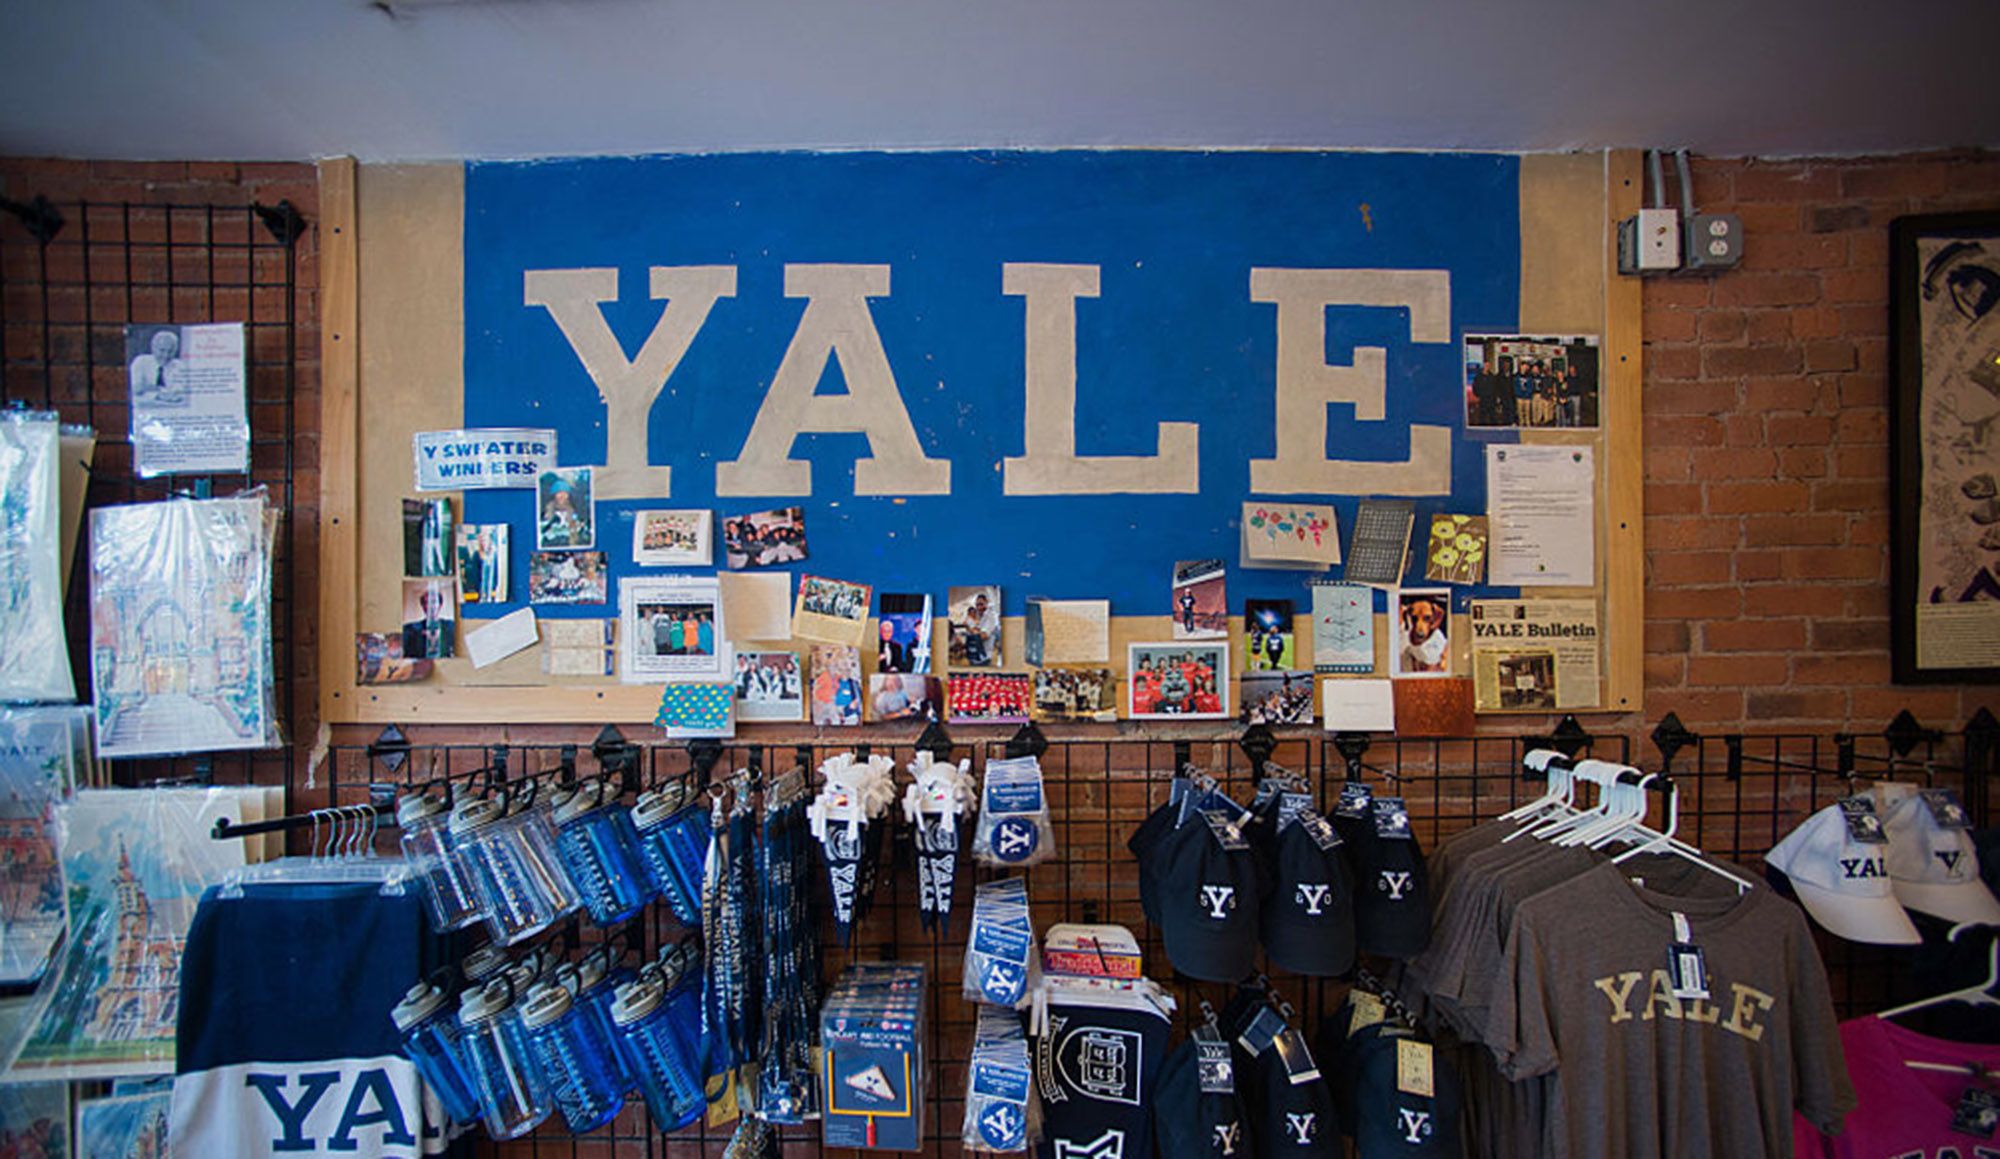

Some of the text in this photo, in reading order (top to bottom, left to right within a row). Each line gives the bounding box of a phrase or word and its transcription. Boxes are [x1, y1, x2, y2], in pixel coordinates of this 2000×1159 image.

[522, 262, 1452, 498] YALE
[424, 445, 437, 459] Y
[1473, 622, 1597, 637] YALE Bulletin
[829, 863, 858, 924] YALE
[929, 854, 956, 915] YALE
[1934, 850, 1968, 878] Y
[713, 917, 727, 1010] UNIVERSITY
